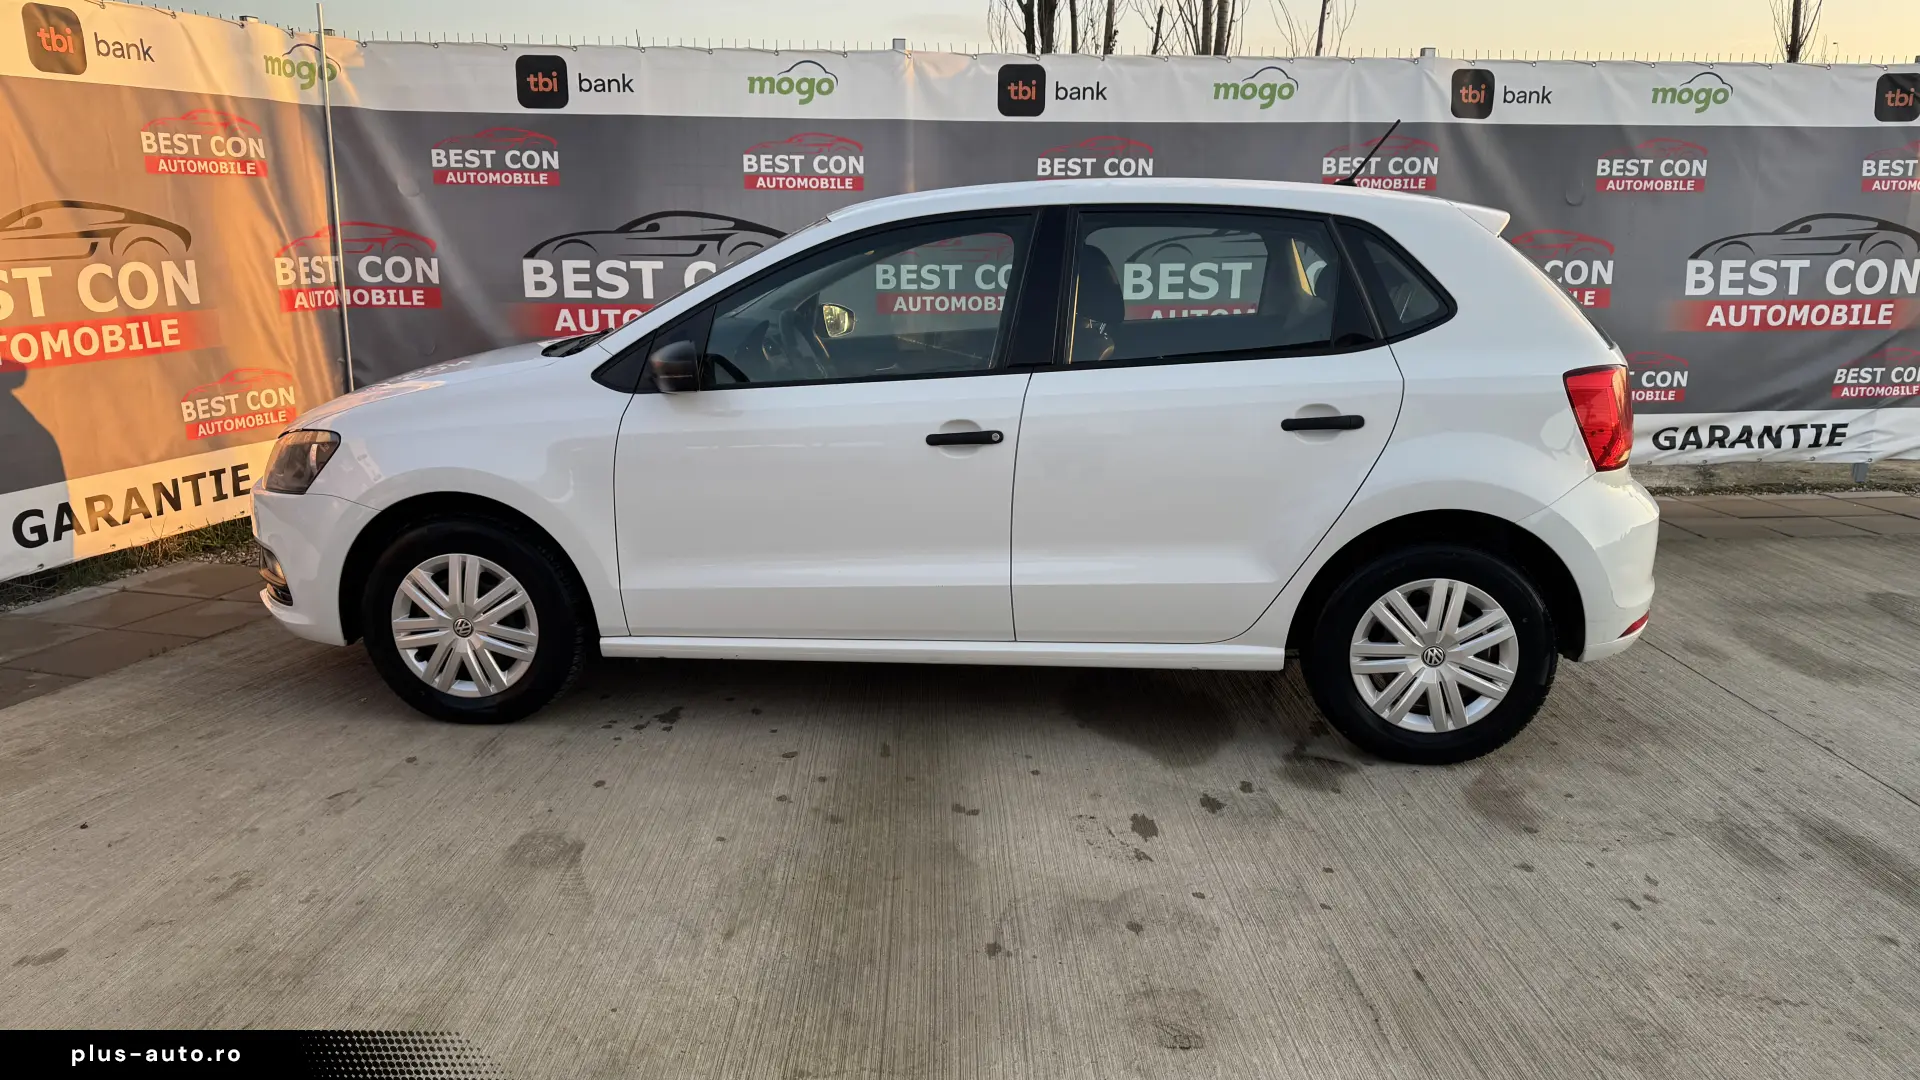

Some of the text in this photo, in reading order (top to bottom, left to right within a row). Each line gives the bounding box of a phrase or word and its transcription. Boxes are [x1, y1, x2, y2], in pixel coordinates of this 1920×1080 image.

[36, 26, 155, 63] tbi bank
[526, 71, 635, 93] tbi bank
[747, 74, 835, 105] mogo
[1007, 80, 1108, 101] tbi bank
[1213, 80, 1295, 110] mogo
[1459, 84, 1552, 104] tbi bank
[1651, 87, 1729, 113] mogo
[1885, 88, 1914, 107] tbi
[140, 131, 266, 159] BEST CON
[157, 159, 257, 175] AUTOMOBILE
[431, 149, 560, 169] BEST CON
[743, 154, 865, 174] BEST CON
[1037, 157, 1154, 177] BEST CON
[1322, 157, 1439, 175] BEST CON
[1596, 159, 1708, 177] BEST CON
[1862, 159, 1919, 177] BEST
[445, 171, 549, 185] AUTOMOBILE
[755, 176, 853, 190] AUTOMOBILE
[1606, 180, 1695, 191] AUTOMOBILE
[1872, 180, 1920, 191] AUTOM
[274, 255, 440, 286] BEST CON
[522, 259, 664, 300] BEST
[875, 264, 963, 290] BEST
[1684, 258, 1920, 297] BEST CON
[77, 259, 201, 313] CON
[1123, 262, 1253, 301] BEST
[294, 289, 425, 309] AUTOMOBILE
[1706, 303, 1895, 327] AUTOMOBILE
[1641, 370, 1689, 388] CON
[1833, 367, 1886, 384] BEST
[1841, 385, 1920, 397] AUTOMOBILE
[181, 386, 296, 423] BEST CON
[197, 410, 287, 437] AUTOMOBILE
[1652, 422, 1849, 451] GARANTIE
[12, 462, 251, 548] GARANTIE
